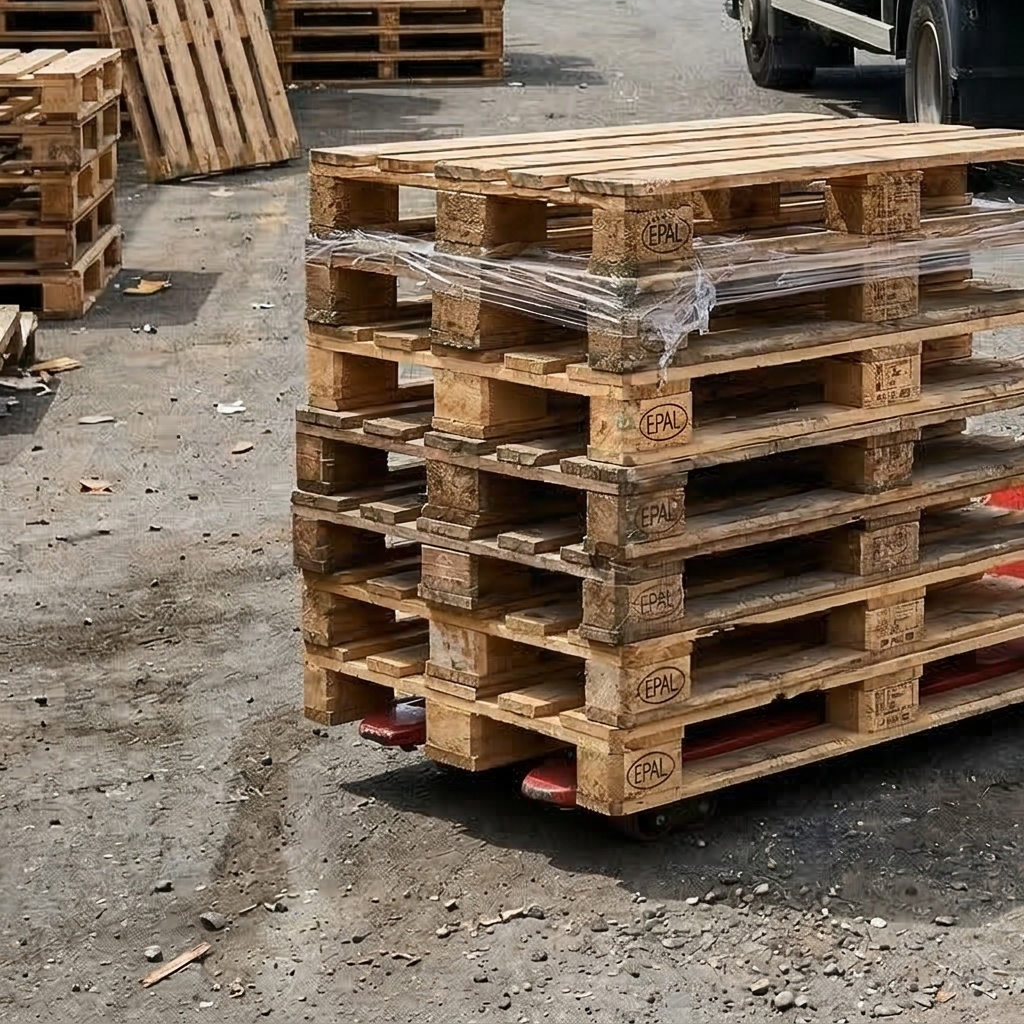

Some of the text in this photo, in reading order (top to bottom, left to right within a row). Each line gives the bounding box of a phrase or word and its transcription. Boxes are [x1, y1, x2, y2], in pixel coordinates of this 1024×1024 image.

[649, 223, 682, 247] EPAL
[646, 410, 681, 435] EPAL
[641, 498, 676, 528] EPAL
[645, 673, 679, 699] EPAL
[634, 757, 668, 784] EPAL
